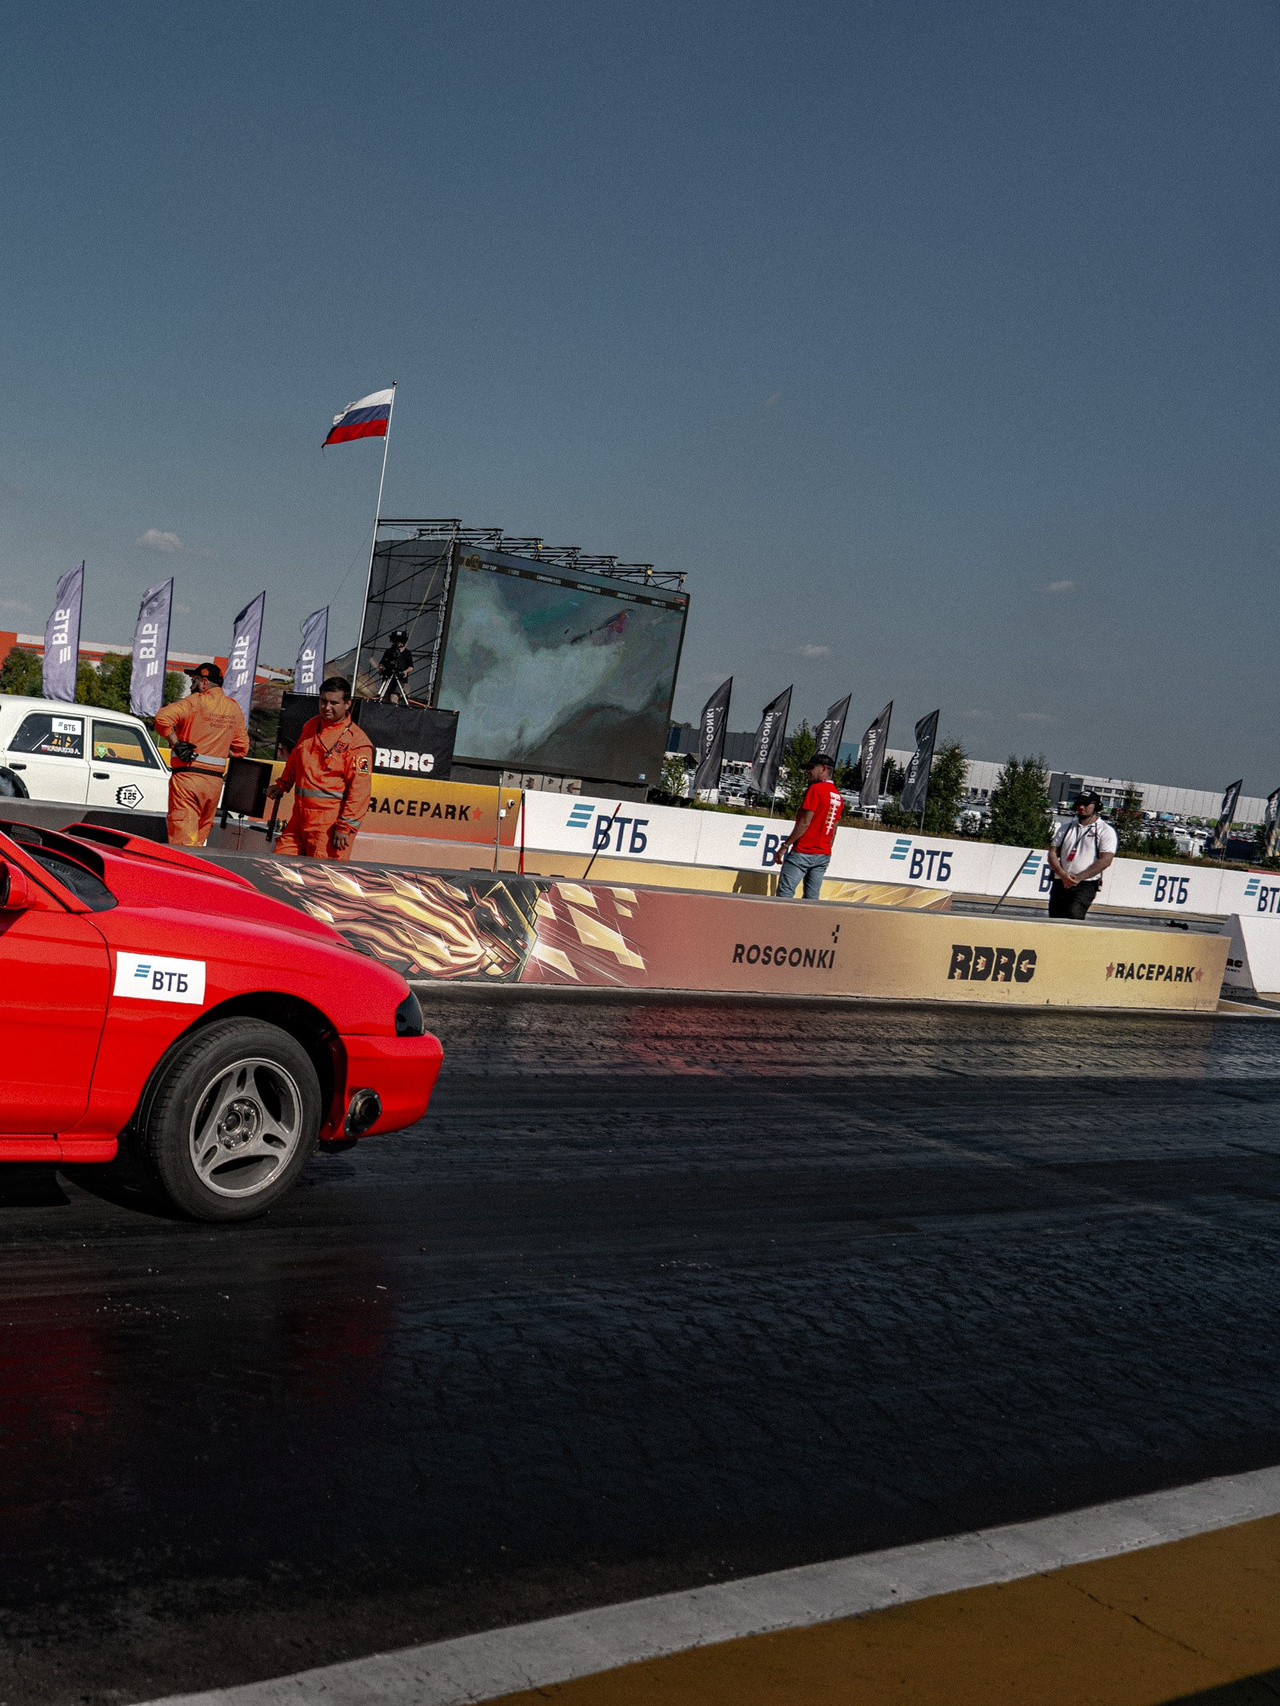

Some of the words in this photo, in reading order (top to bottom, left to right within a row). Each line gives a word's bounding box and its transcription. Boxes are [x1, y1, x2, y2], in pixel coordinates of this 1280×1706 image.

[63, 723, 76, 732] ВТБ
[375, 747, 435, 772] RDRC
[123, 792, 136, 800] 125
[367, 796, 472, 821] RACEPARK
[593, 815, 649, 853] ВТБ
[909, 848, 953, 882] ВТБ
[1154, 875, 1190, 904] ВТБ
[733, 943, 835, 969] ROSGONKI
[948, 944, 1038, 983] RDRC
[151, 970, 189, 993] ВТБ
[1115, 962, 1195, 983] RACEPARK
